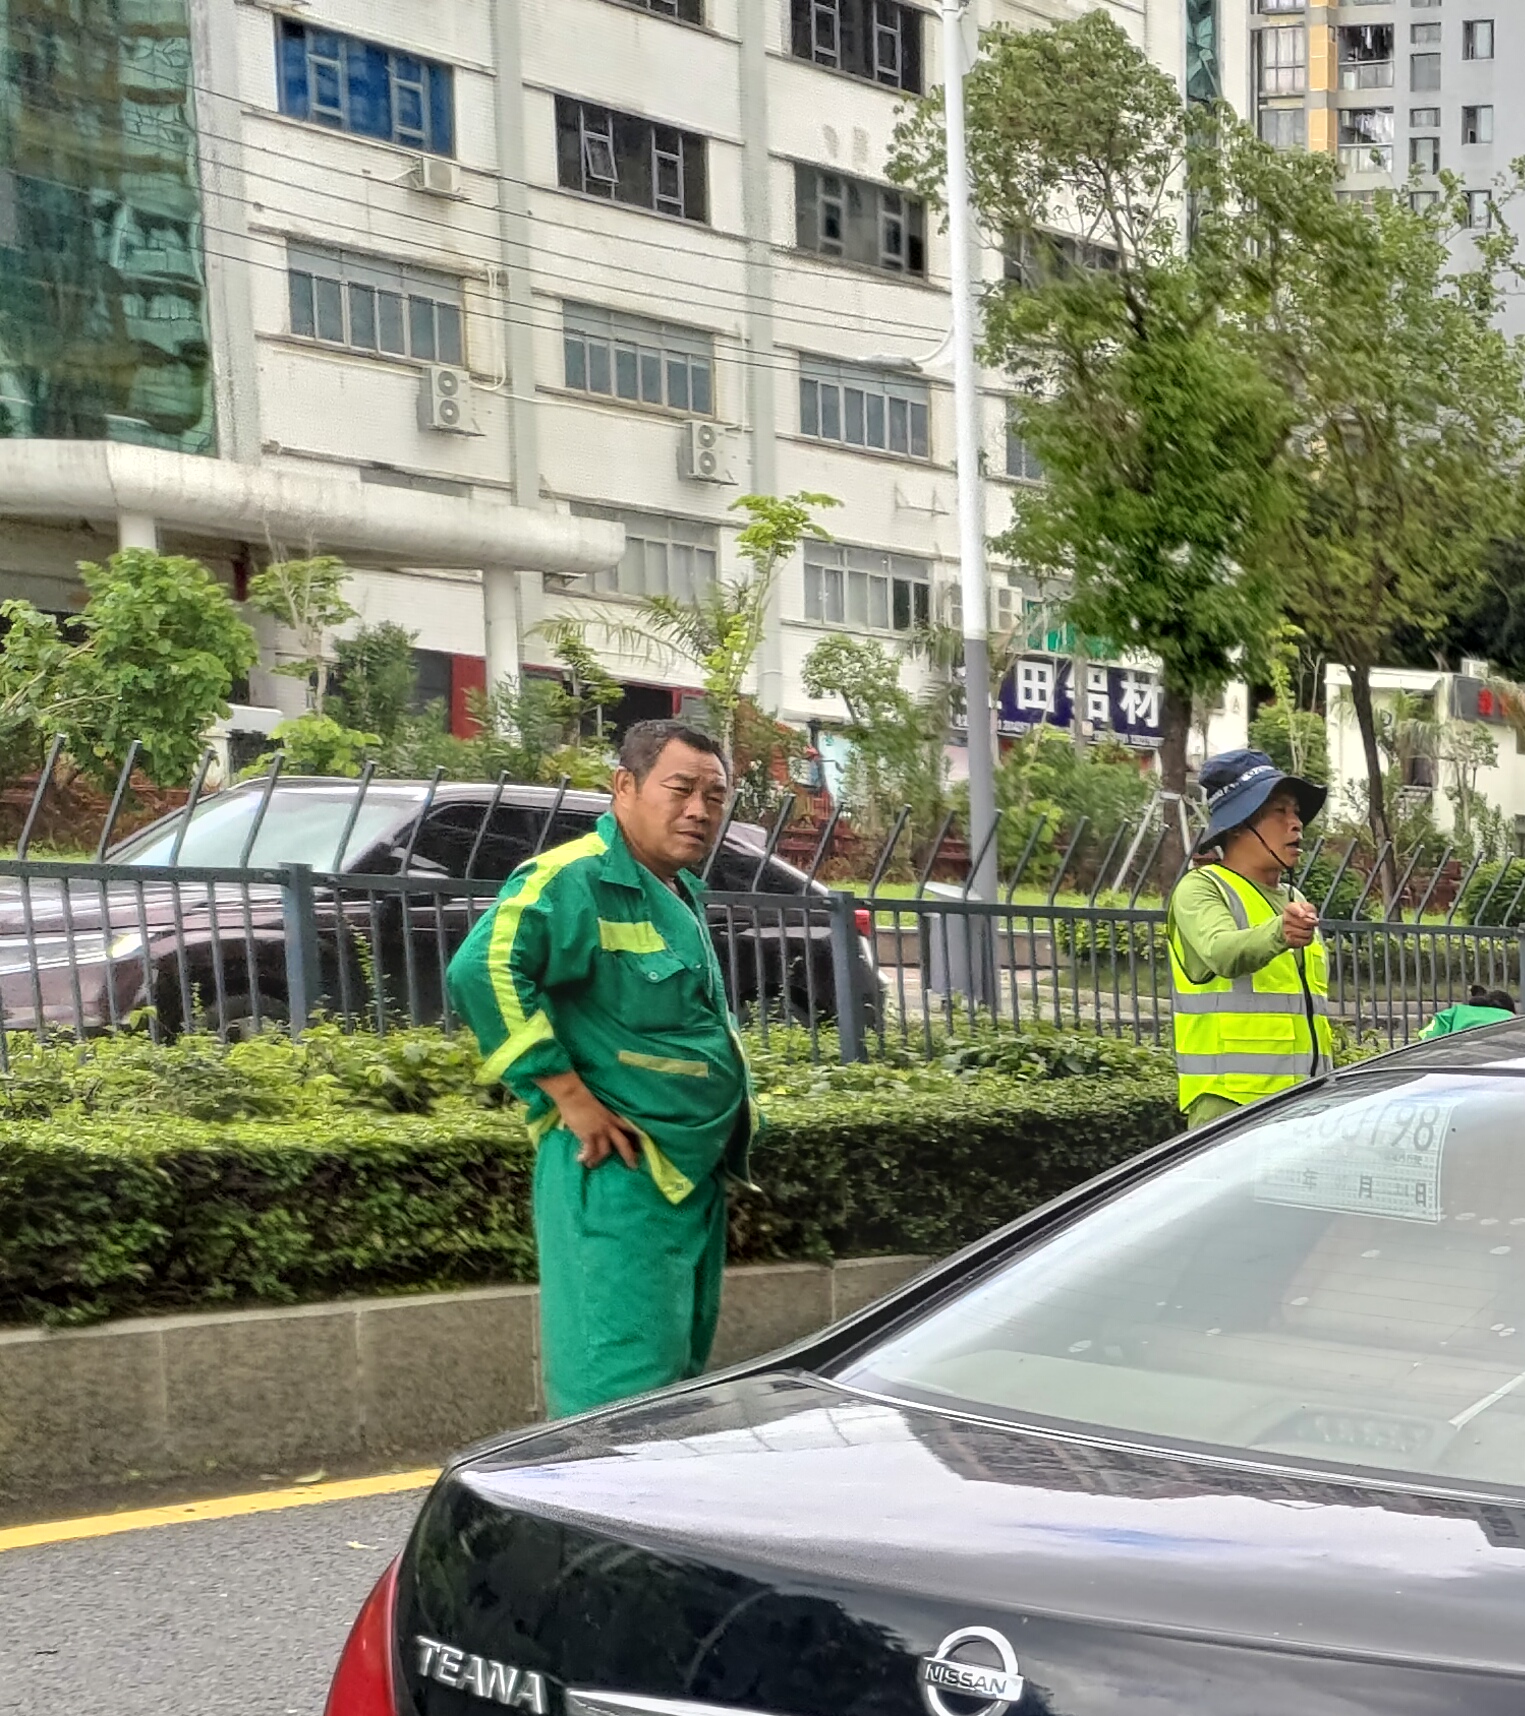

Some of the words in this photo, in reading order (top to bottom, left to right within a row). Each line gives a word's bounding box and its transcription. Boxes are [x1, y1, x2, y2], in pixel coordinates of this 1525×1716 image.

[957, 659, 1165, 728] 田铝材
[1357, 1174, 1373, 1199] 月
[1415, 1182, 1427, 1208] 日
[415, 1634, 548, 1716] TEANA
[924, 1663, 1008, 1696] NISSAN
